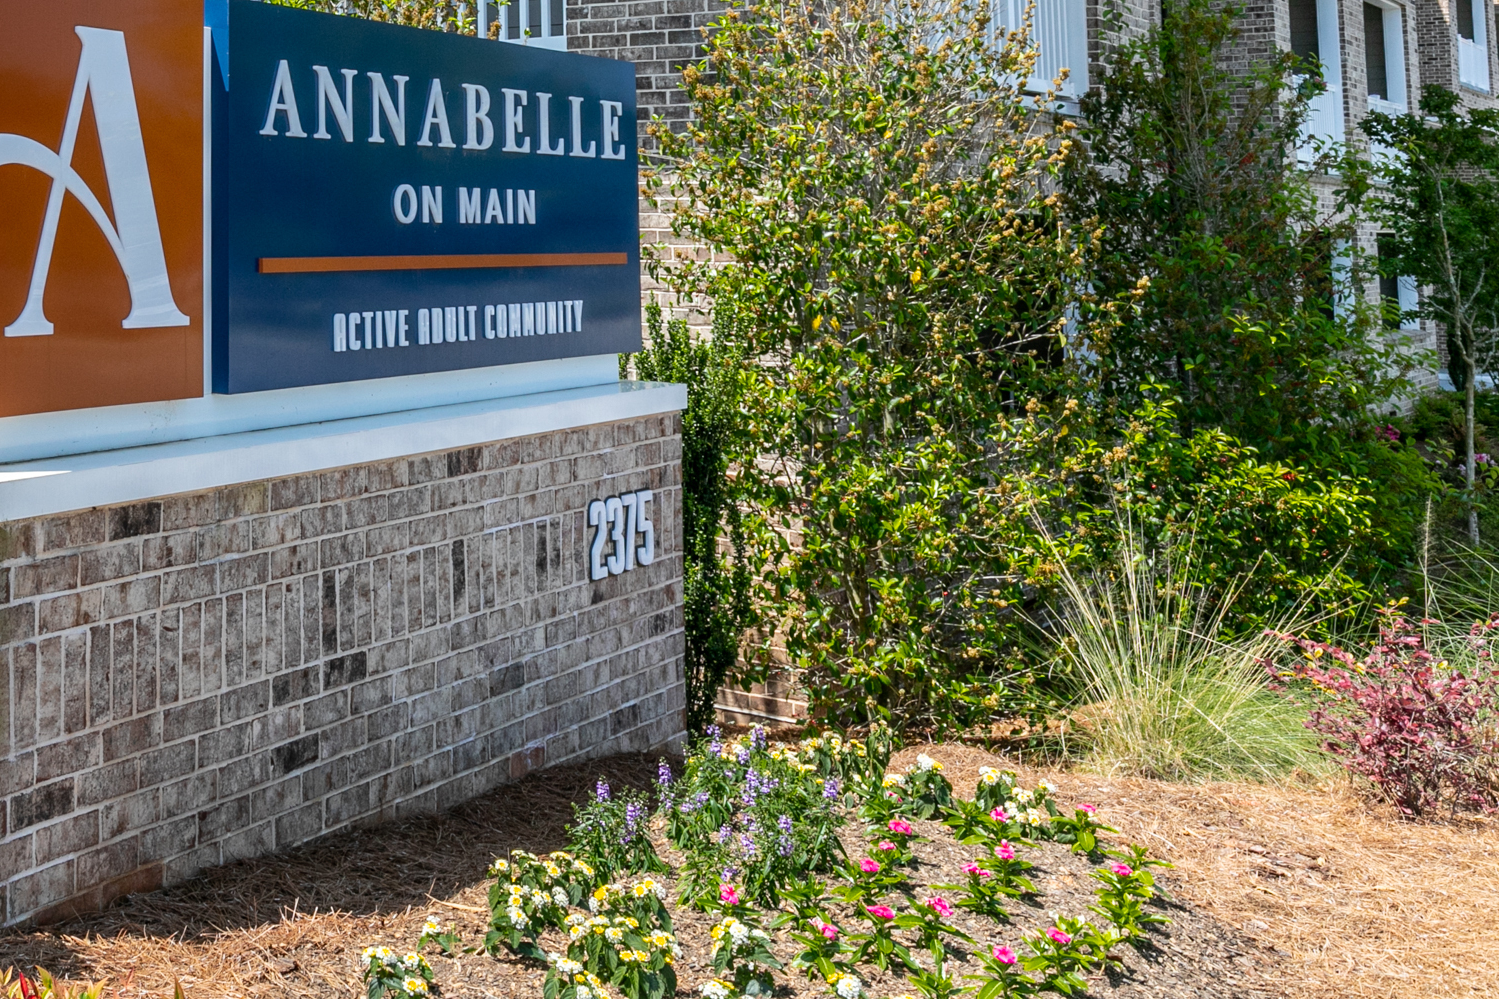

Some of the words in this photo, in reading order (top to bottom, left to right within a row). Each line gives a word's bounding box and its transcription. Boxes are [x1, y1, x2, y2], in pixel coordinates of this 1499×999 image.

[258, 59, 626, 161] ANNABELLE
[393, 183, 443, 225] ON
[458, 186, 536, 225] MAIN
[333, 309, 409, 352] ACTIVE
[417, 305, 477, 345] ADULT
[484, 300, 584, 339] COMMUNITY
[589, 489, 655, 580] 2375
